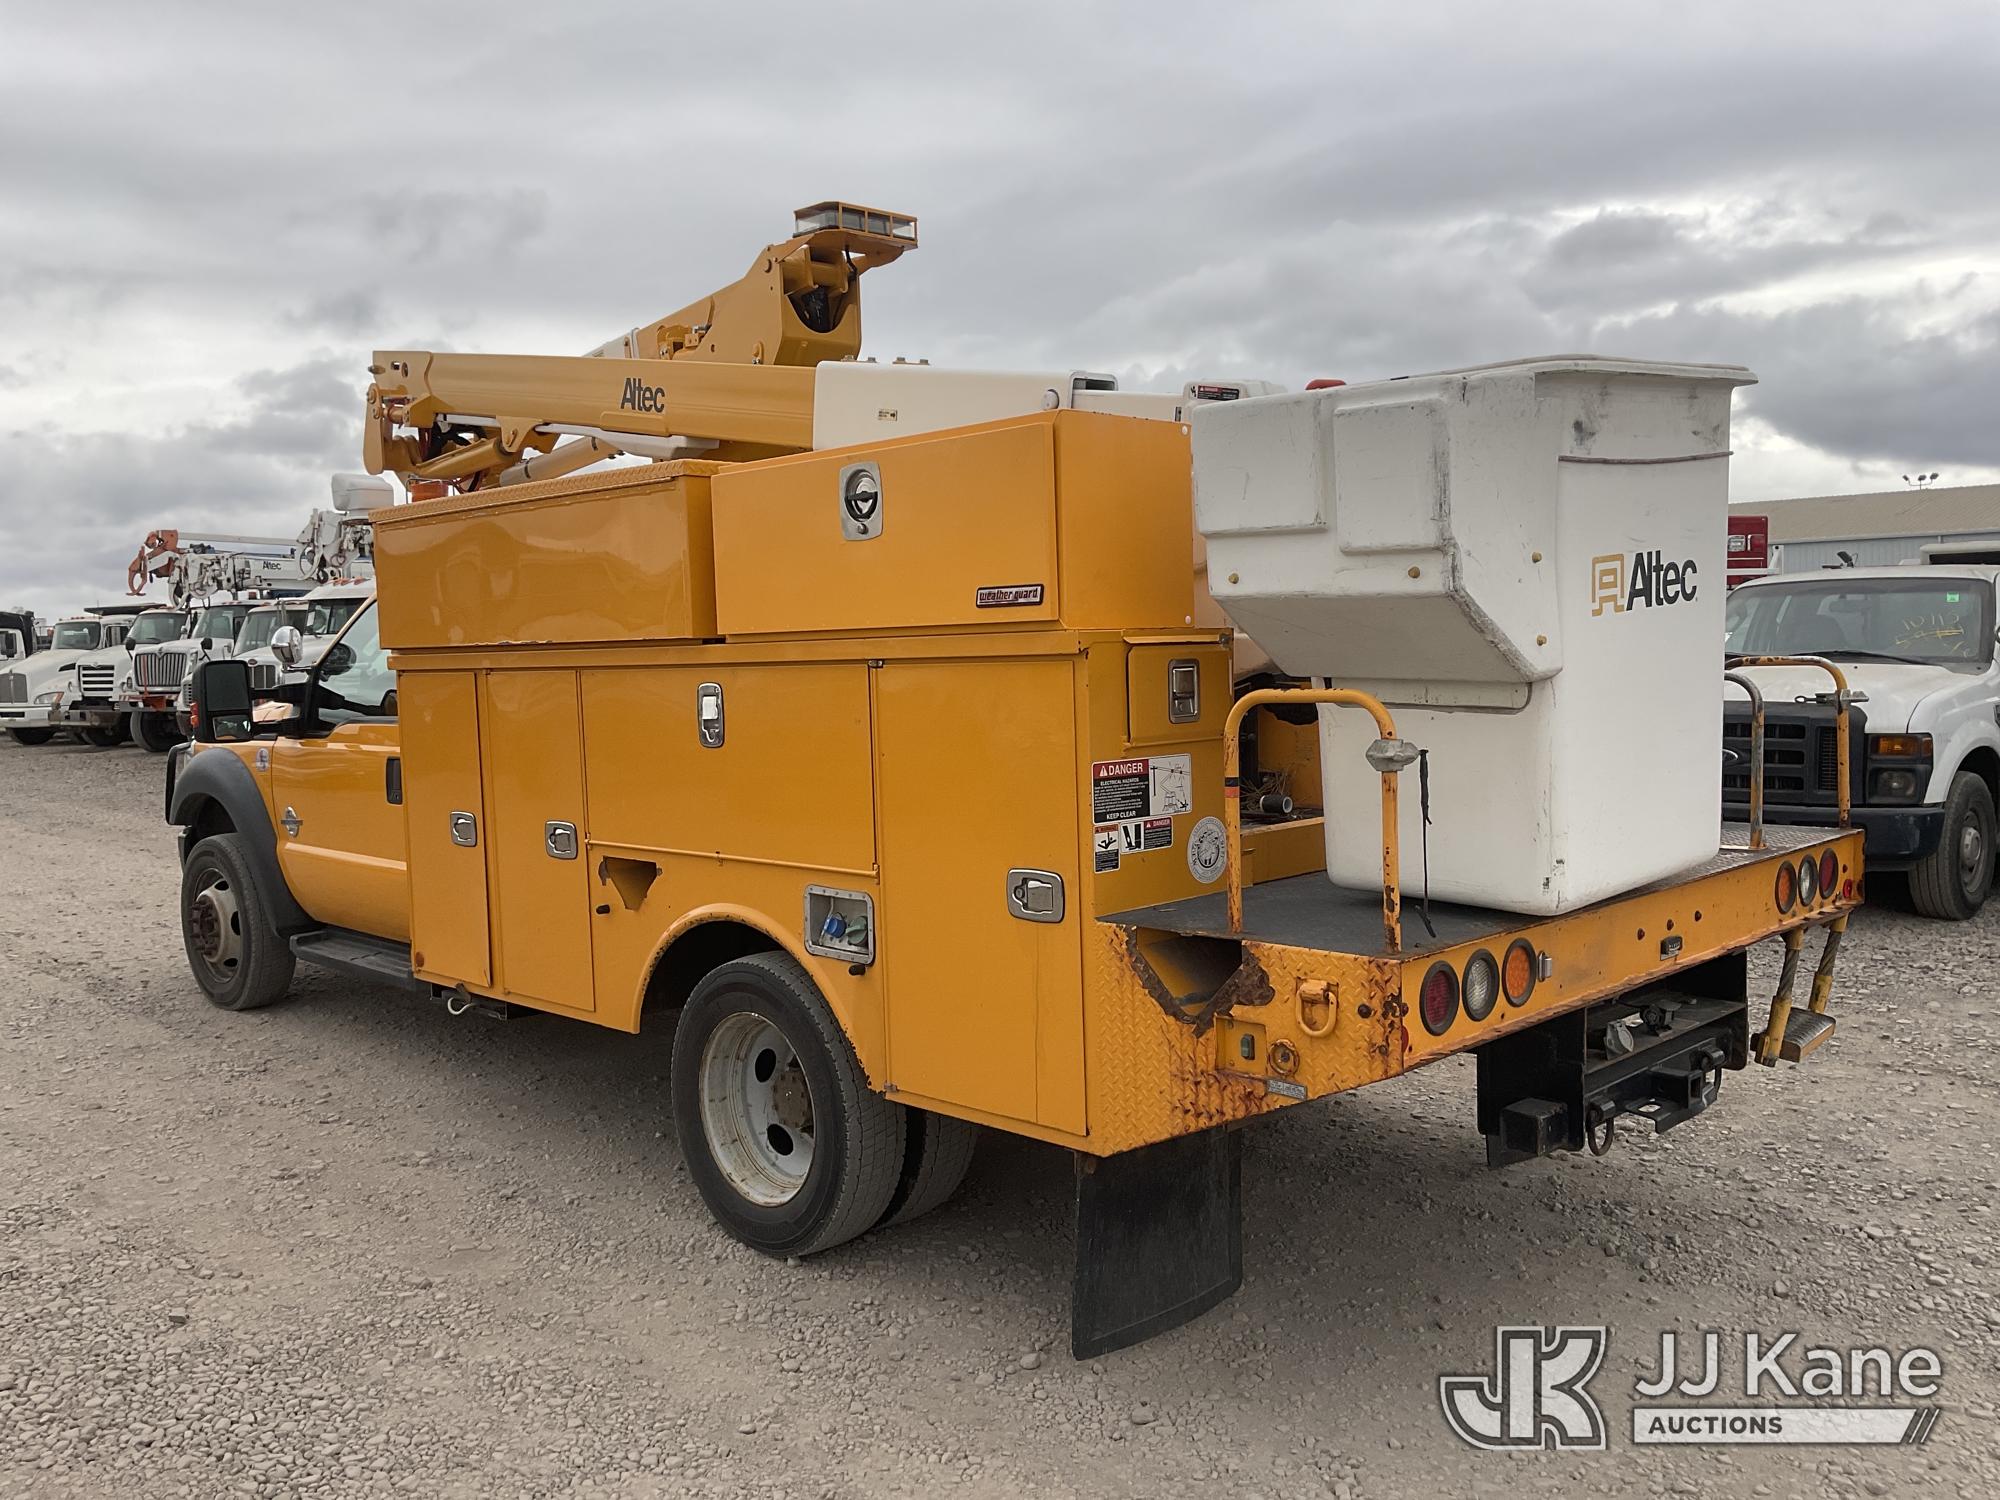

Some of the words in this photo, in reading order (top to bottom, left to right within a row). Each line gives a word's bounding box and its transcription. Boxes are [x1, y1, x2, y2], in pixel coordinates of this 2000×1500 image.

[620, 377, 665, 413] Altec
[1626, 549, 1698, 612] Altec
[980, 590, 1013, 601] weather
[1013, 588, 1038, 600] guard
[1108, 762, 1143, 776] DANGER
[1152, 818, 1171, 827] DANGER
